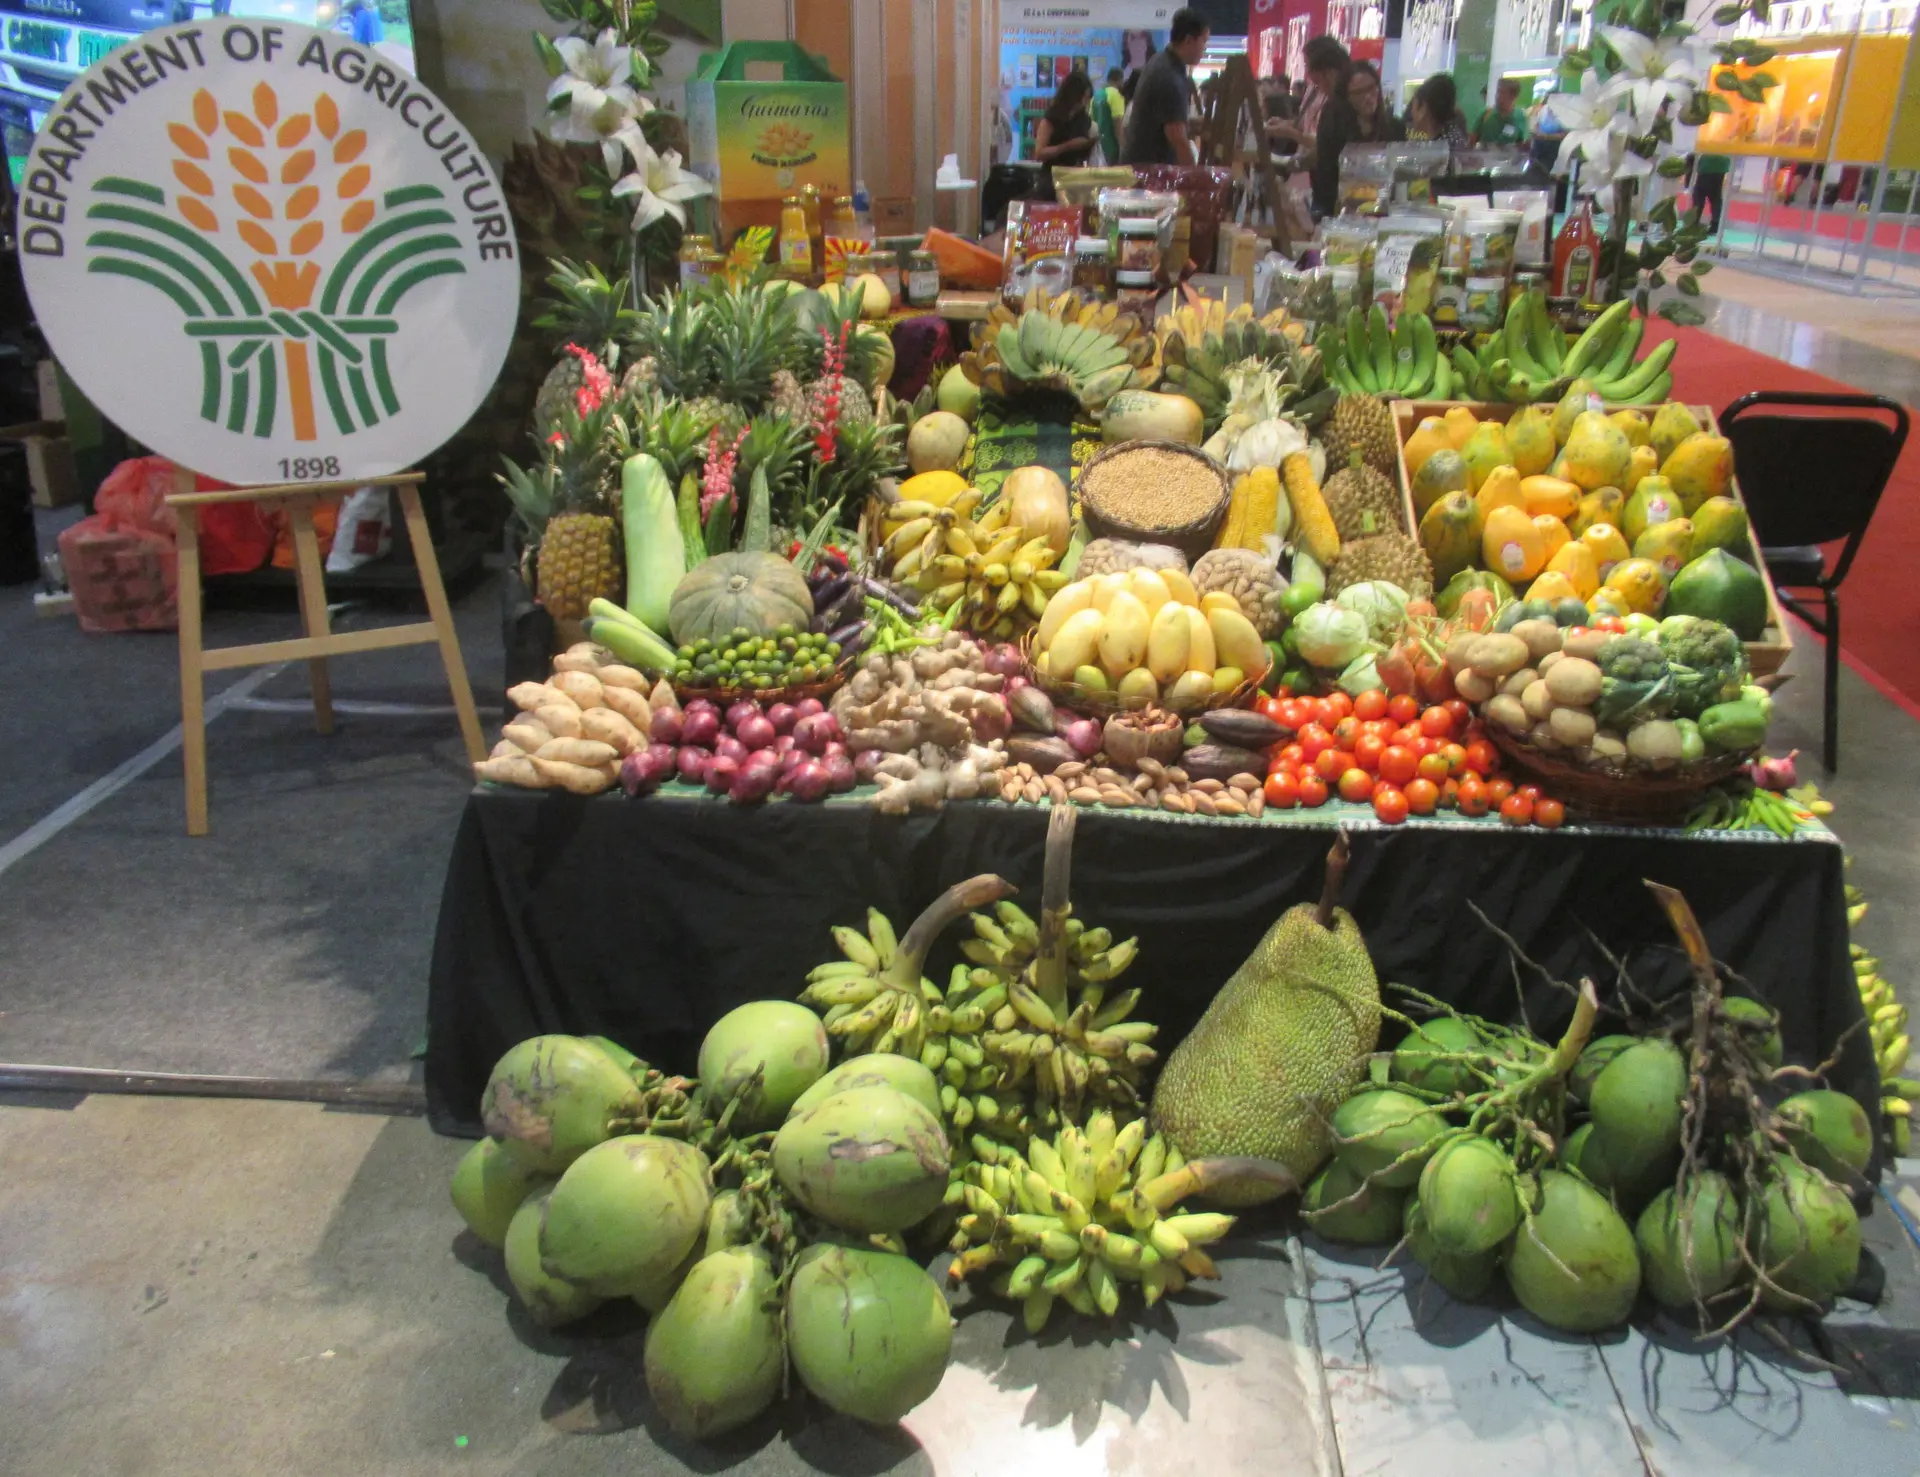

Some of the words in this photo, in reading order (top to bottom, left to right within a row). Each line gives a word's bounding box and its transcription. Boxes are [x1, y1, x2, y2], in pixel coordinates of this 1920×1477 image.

[740, 94, 830, 120] Guimaras
[23, 27, 208, 257] DEPARTMENT
[222, 23, 283, 63] OF
[297, 35, 514, 262] AGRICULTURE
[277, 455, 341, 480] 1898
